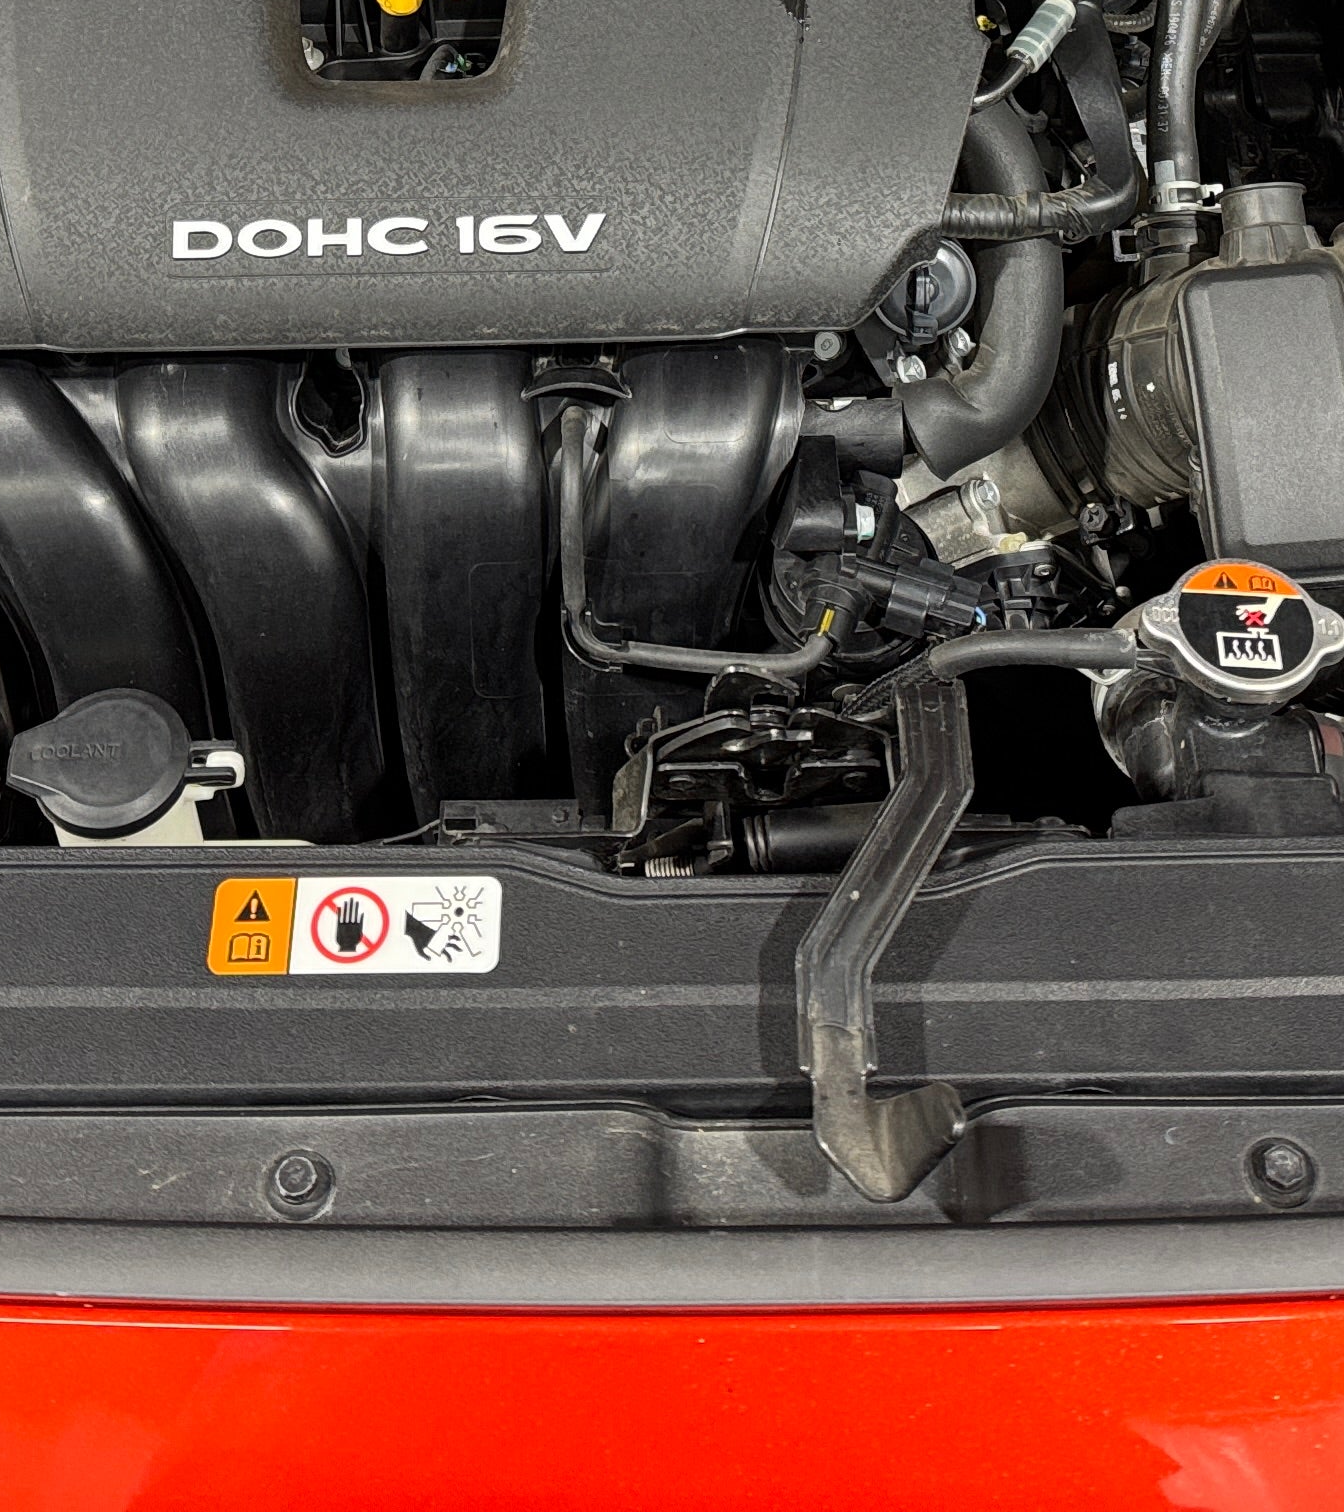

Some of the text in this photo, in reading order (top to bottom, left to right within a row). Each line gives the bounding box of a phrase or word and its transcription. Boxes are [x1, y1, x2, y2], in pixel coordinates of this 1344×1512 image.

[172, 213, 606, 260] DOHC 16V
[30, 743, 122, 760] COOLANT
